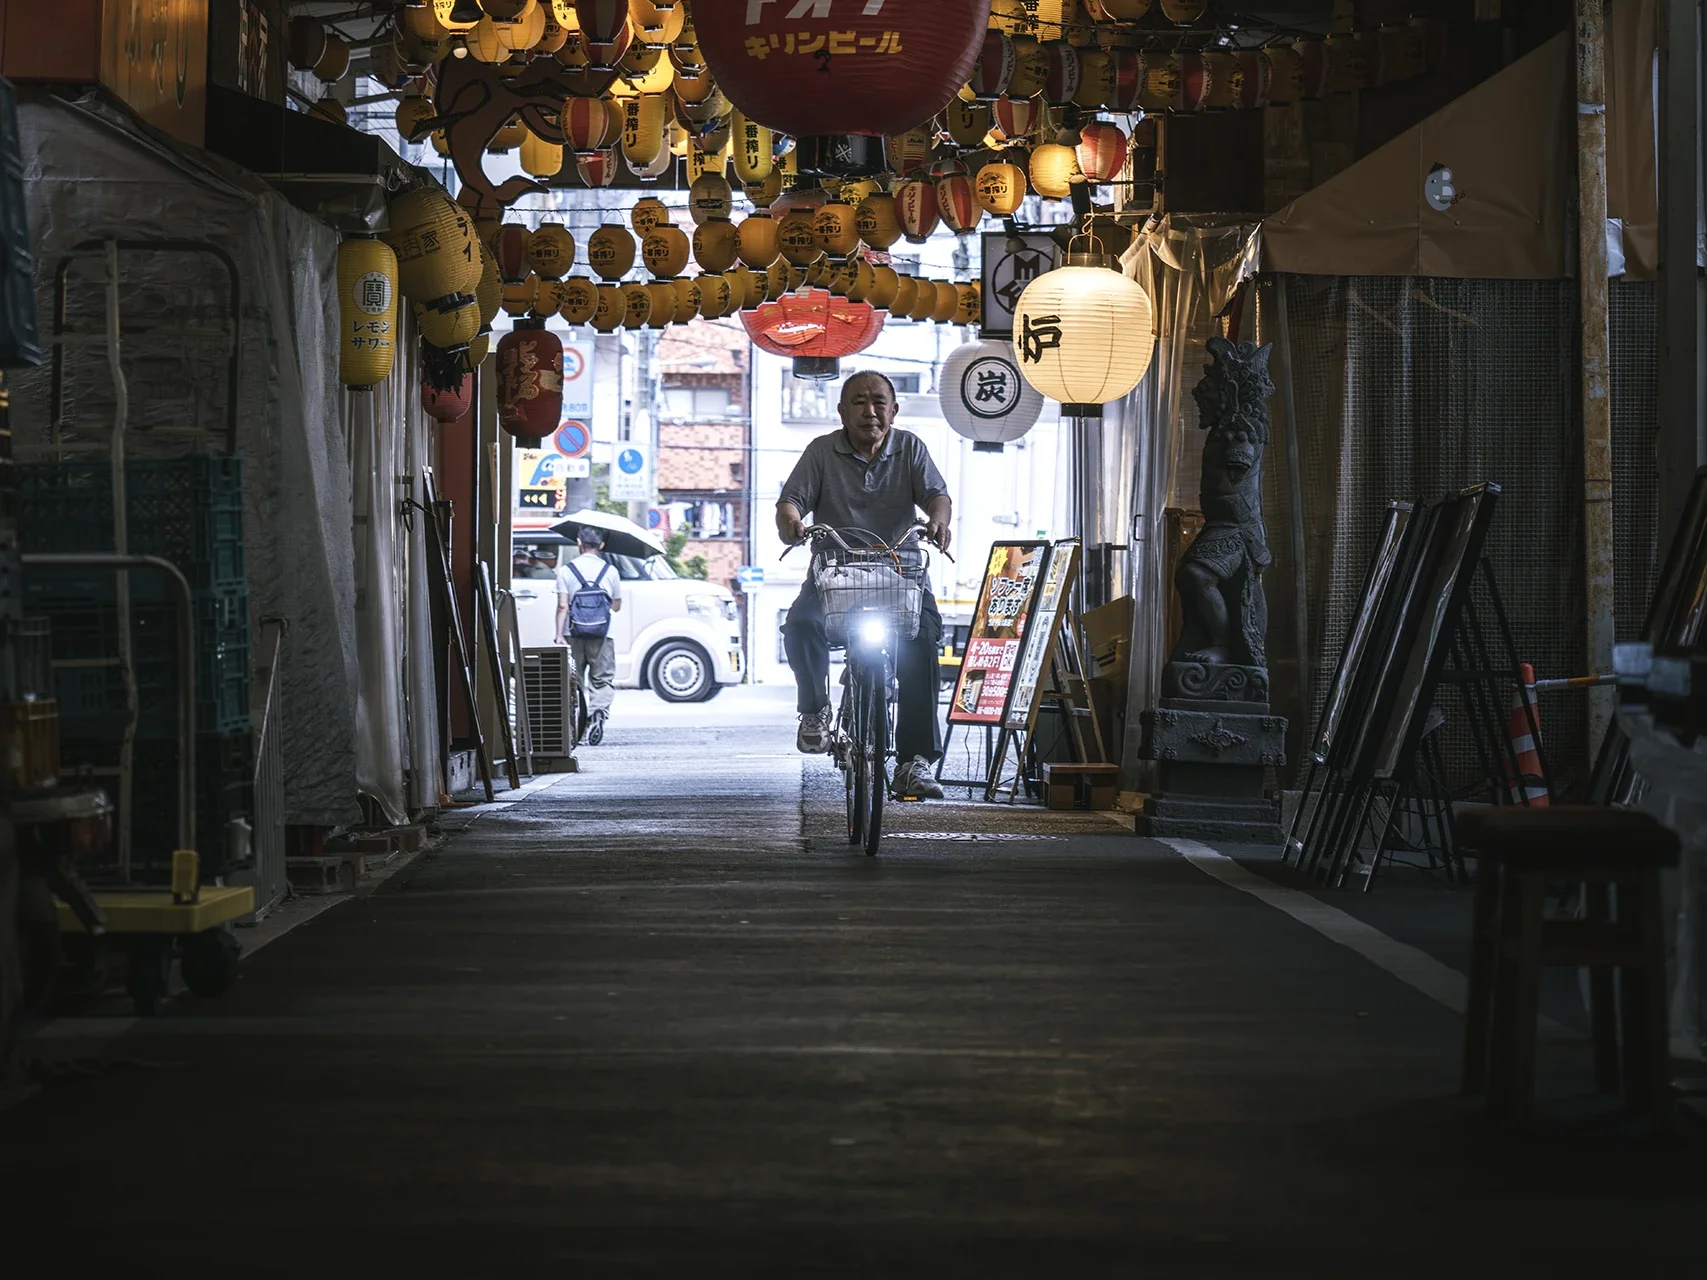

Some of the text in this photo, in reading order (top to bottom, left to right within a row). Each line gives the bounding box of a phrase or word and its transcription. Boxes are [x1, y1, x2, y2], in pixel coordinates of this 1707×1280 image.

[744, 31, 903, 60] キリンビール
[625, 102, 640, 148] 番搾り
[745, 123, 759, 170] 番搾り
[978, 184, 1009, 195] 一番搾り
[907, 184, 918, 225] キリンビール
[814, 226, 842, 235] 一番搾り
[856, 220, 878, 231] 番搾り
[781, 236, 813, 246] 一番搾り
[529, 248, 559, 258] 一番搾り
[589, 249, 616, 260] 一番搾り
[642, 248, 670, 258] 一番搾り
[564, 297, 590, 307] 一番搾り
[352, 320, 391, 334] レモン
[351, 336, 391, 351] サワー
[974, 370, 1007, 404] 炭
[988, 597, 1021, 616] あります
